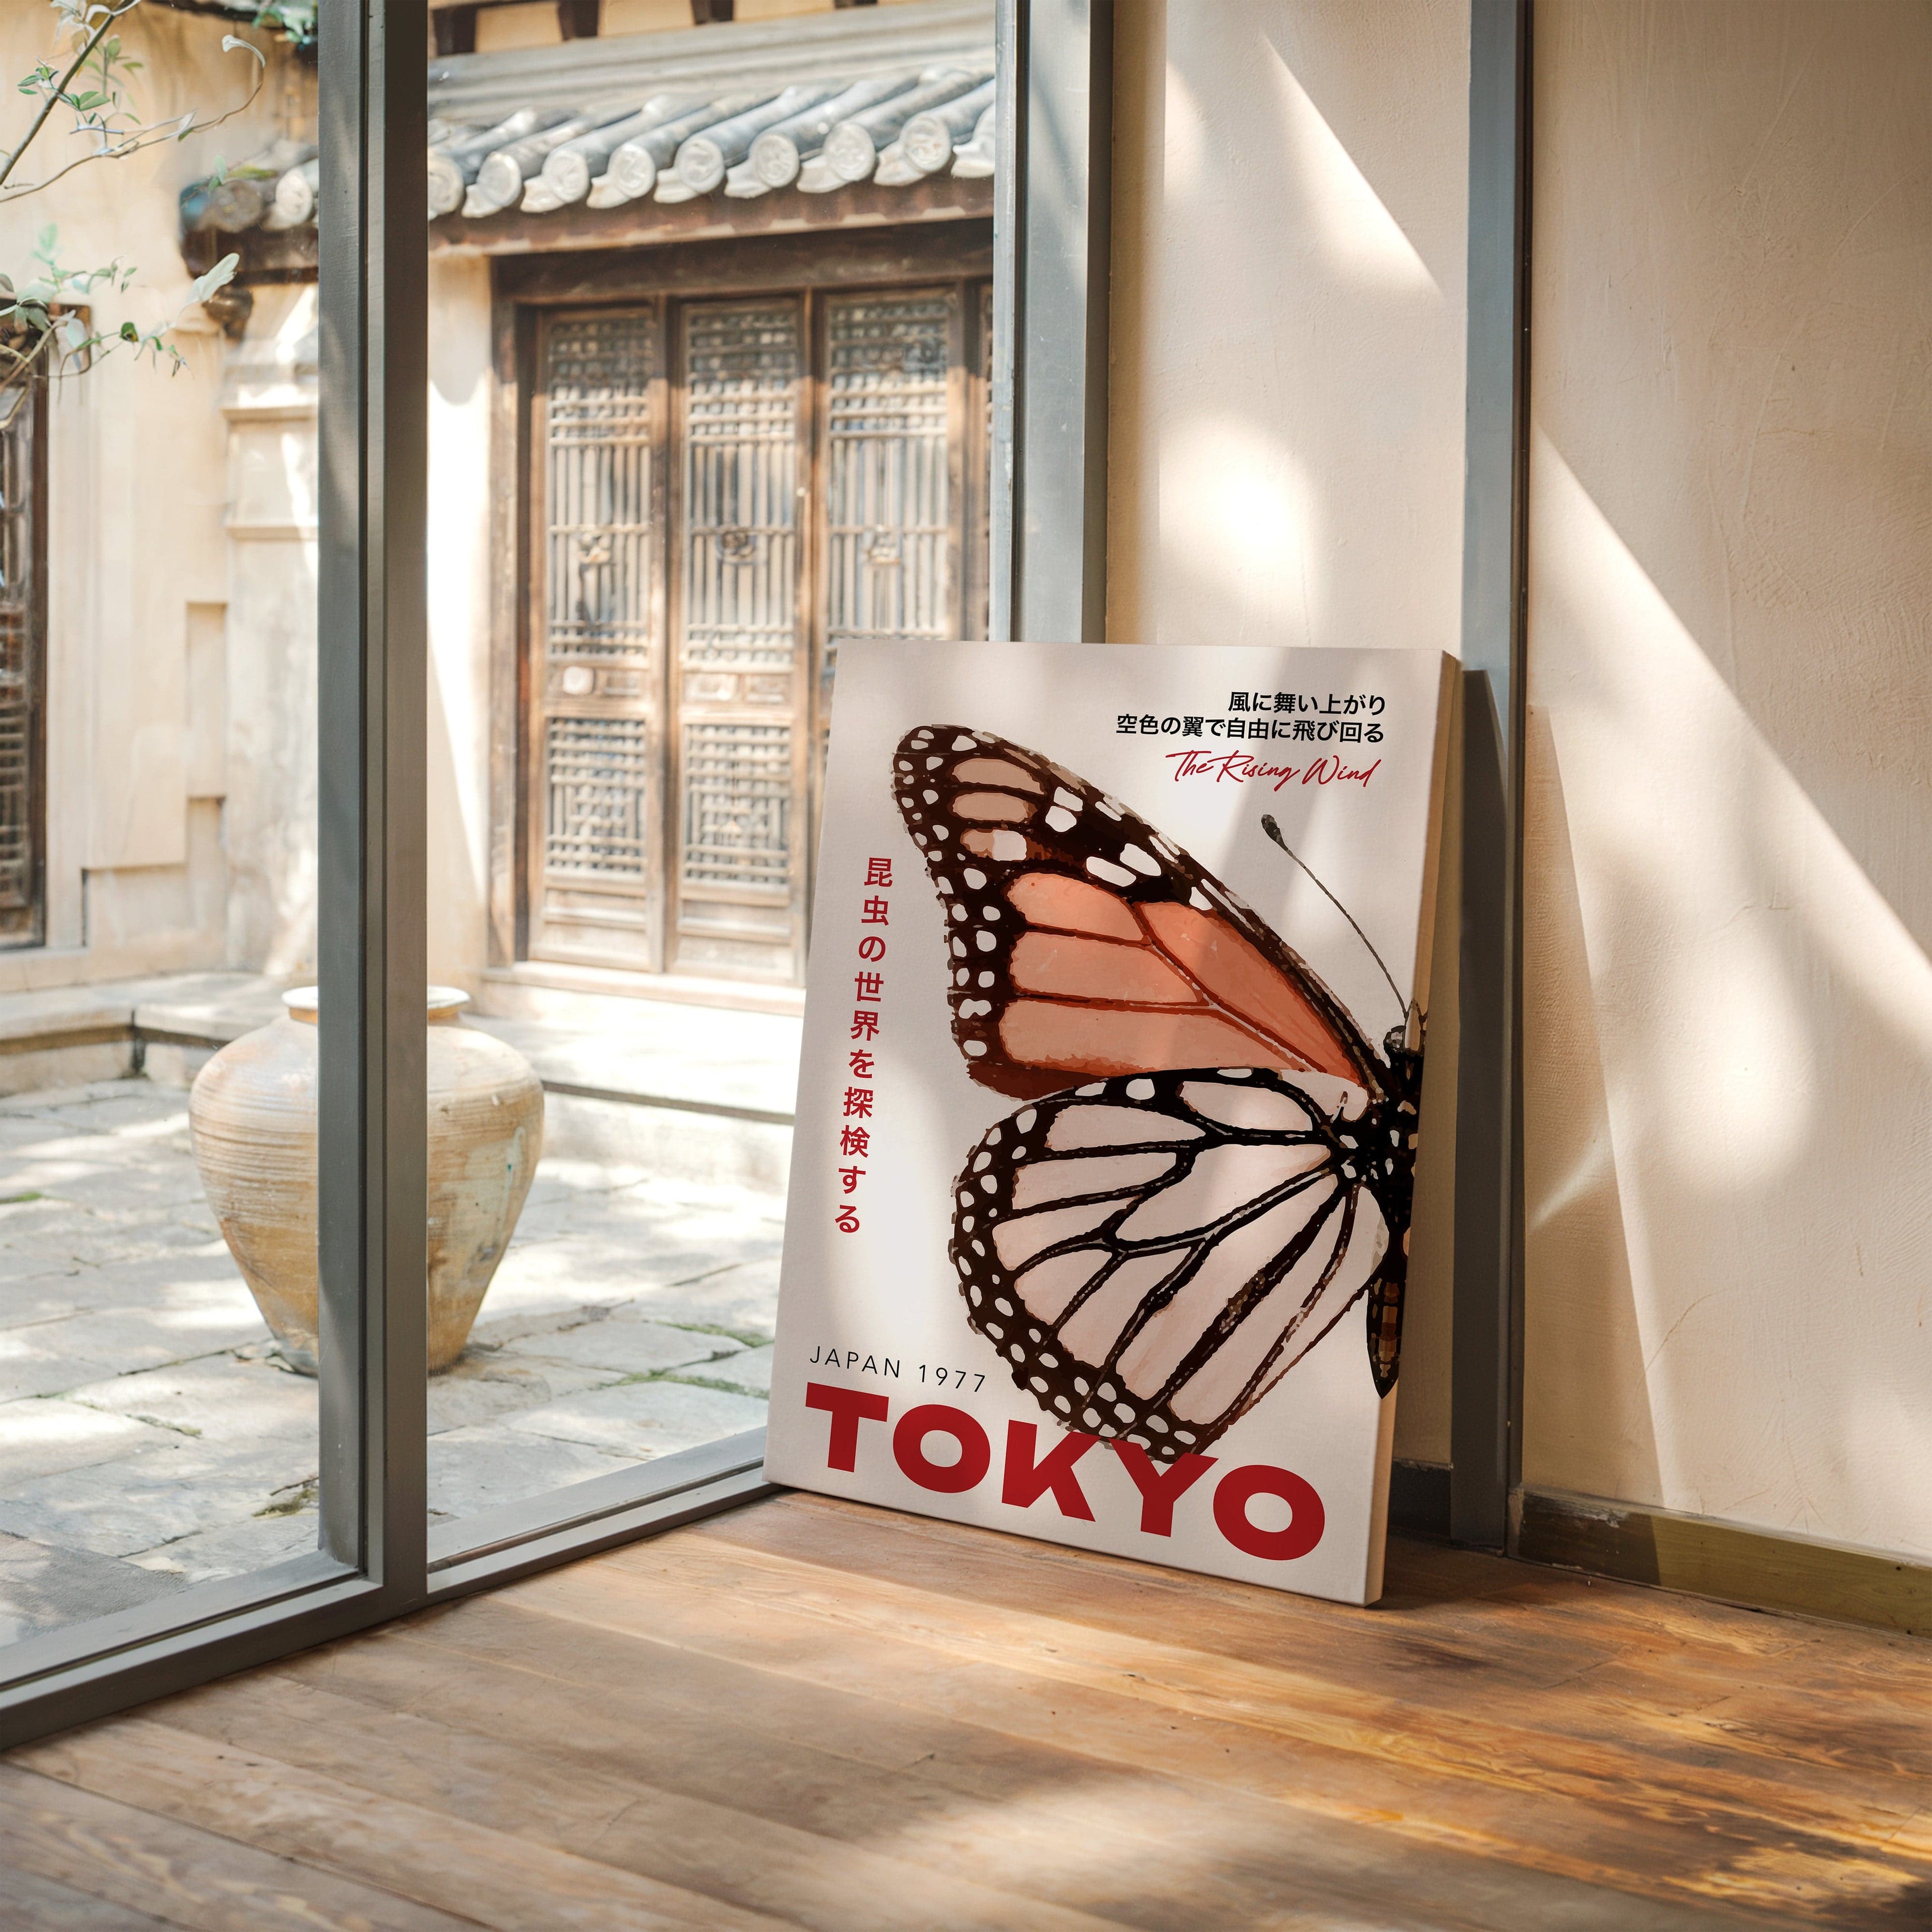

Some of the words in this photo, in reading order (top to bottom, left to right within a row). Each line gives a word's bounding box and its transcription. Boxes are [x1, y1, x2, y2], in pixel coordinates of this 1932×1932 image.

[1228, 691, 1385, 715] 風に舞い上がり
[1116, 714, 1384, 743] 空色の翼で自由に飛び回る
[1165, 750, 1214, 782] The
[1207, 750, 1301, 792] Rising
[1302, 755, 1382, 787] Wind
[834, 857, 893, 1234] 昆虫の世界を探検する
[810, 1346, 901, 1379] JAPAN
[918, 1364, 986, 1393] 1977
[805, 1382, 1325, 1561] TOKYO
